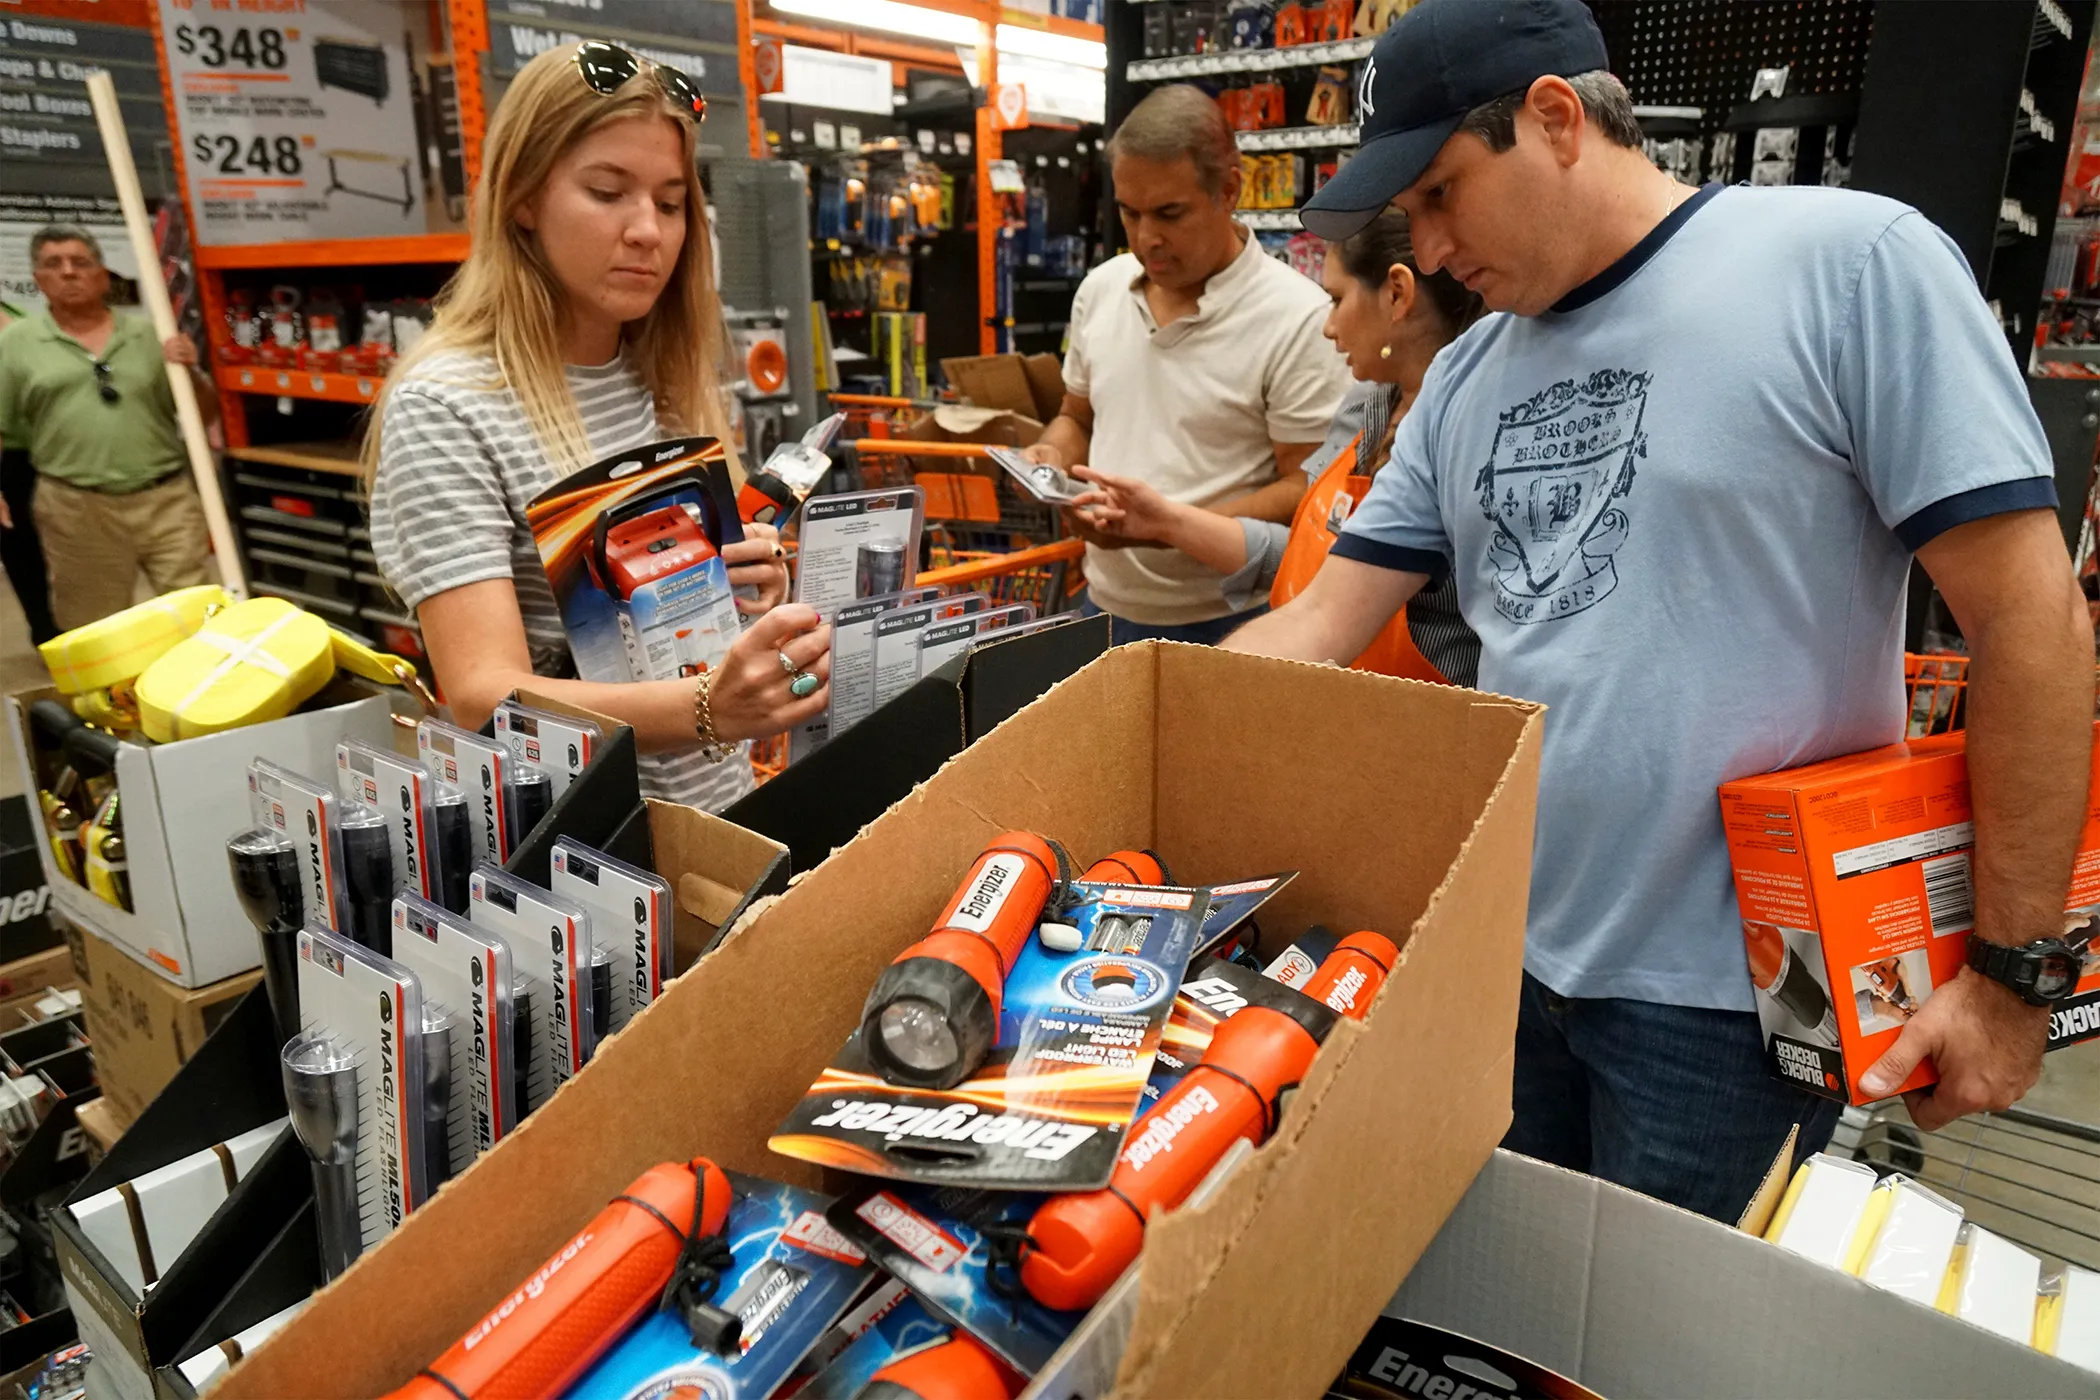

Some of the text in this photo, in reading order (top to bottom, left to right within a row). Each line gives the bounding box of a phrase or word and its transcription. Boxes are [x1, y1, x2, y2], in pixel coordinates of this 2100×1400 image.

[11, 20, 78, 46] Downs
[176, 24, 287, 69] $348
[33, 94, 92, 116] Boxes
[0, 125, 81, 149] Staplers
[194, 134, 302, 174] $248
[1532, 408, 1617, 443] BROOKS
[655, 445, 685, 463] Energizer
[1513, 427, 1621, 466] BROTHERS
[818, 502, 857, 514] MAGLITE LED
[845, 605, 884, 619] MAGLITE LED
[1550, 585, 1596, 614] 1818
[886, 614, 926, 629] MAGLITE LED
[932, 625, 970, 640] MAGLITE LED
[482, 794, 498, 867] MAGLI
[402, 816, 419, 892] MAGLI
[309, 842, 328, 924] MAGLI
[959, 864, 1011, 921] Energizer
[634, 928, 648, 1008] MAGLI
[548, 1013, 556, 1041] LED
[551, 959, 569, 1071] MAGLITE
[471, 992, 488, 1106] MAGLITE
[1062, 1042, 1137, 1059] LED LIGHT
[1089, 1033, 1142, 1047] LAMPE
[1776, 1038, 1821, 1070] DECKER
[467, 1048, 475, 1076] LED
[380, 1028, 397, 1150] MAGLITE
[811, 1100, 1098, 1162] Energizer
[1121, 1085, 1220, 1172] Energizer
[375, 1087, 391, 1226] LED FLASHLIGHT
[464, 1233, 595, 1351] Energizer
